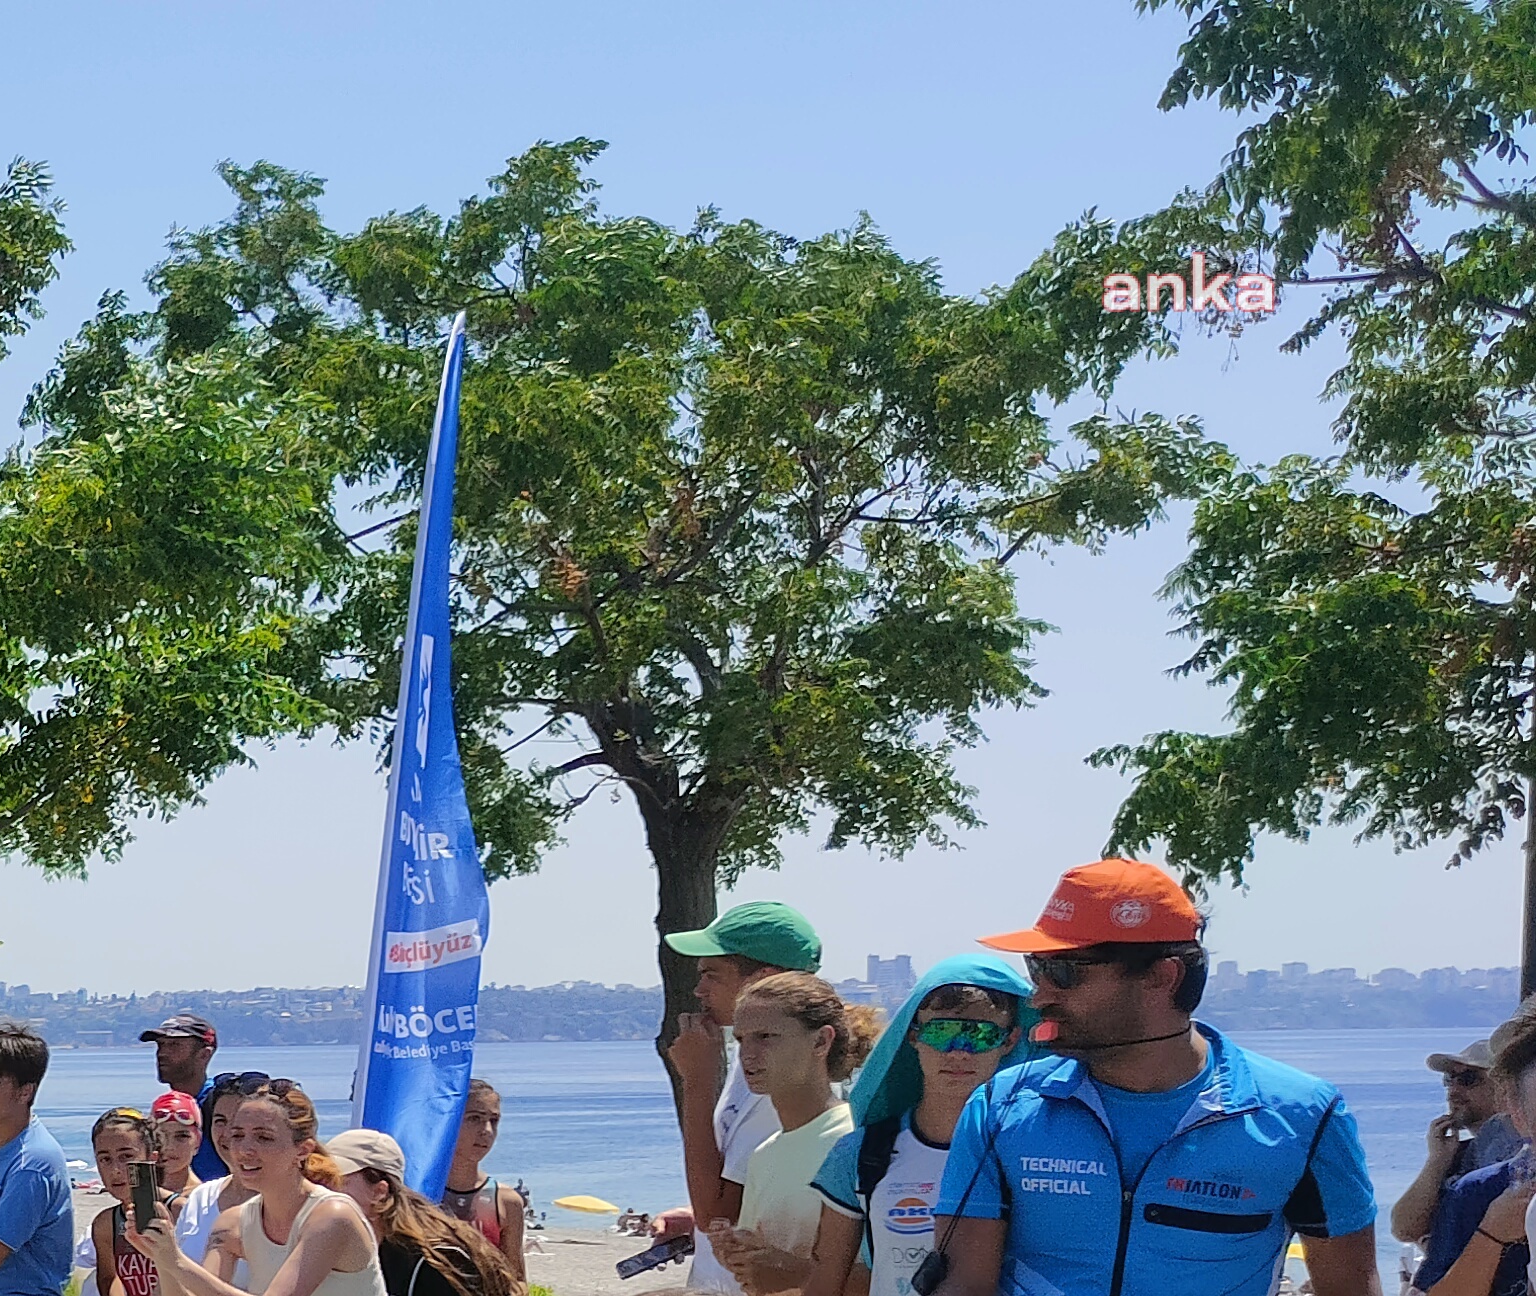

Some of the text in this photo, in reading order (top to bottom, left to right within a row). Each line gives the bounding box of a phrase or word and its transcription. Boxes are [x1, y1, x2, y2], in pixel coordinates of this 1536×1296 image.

[395, 1004, 477, 1039] BÖCE
[1020, 1157, 1107, 1177] TECHNICAL
[1021, 1178, 1091, 1195] OFFICIAL
